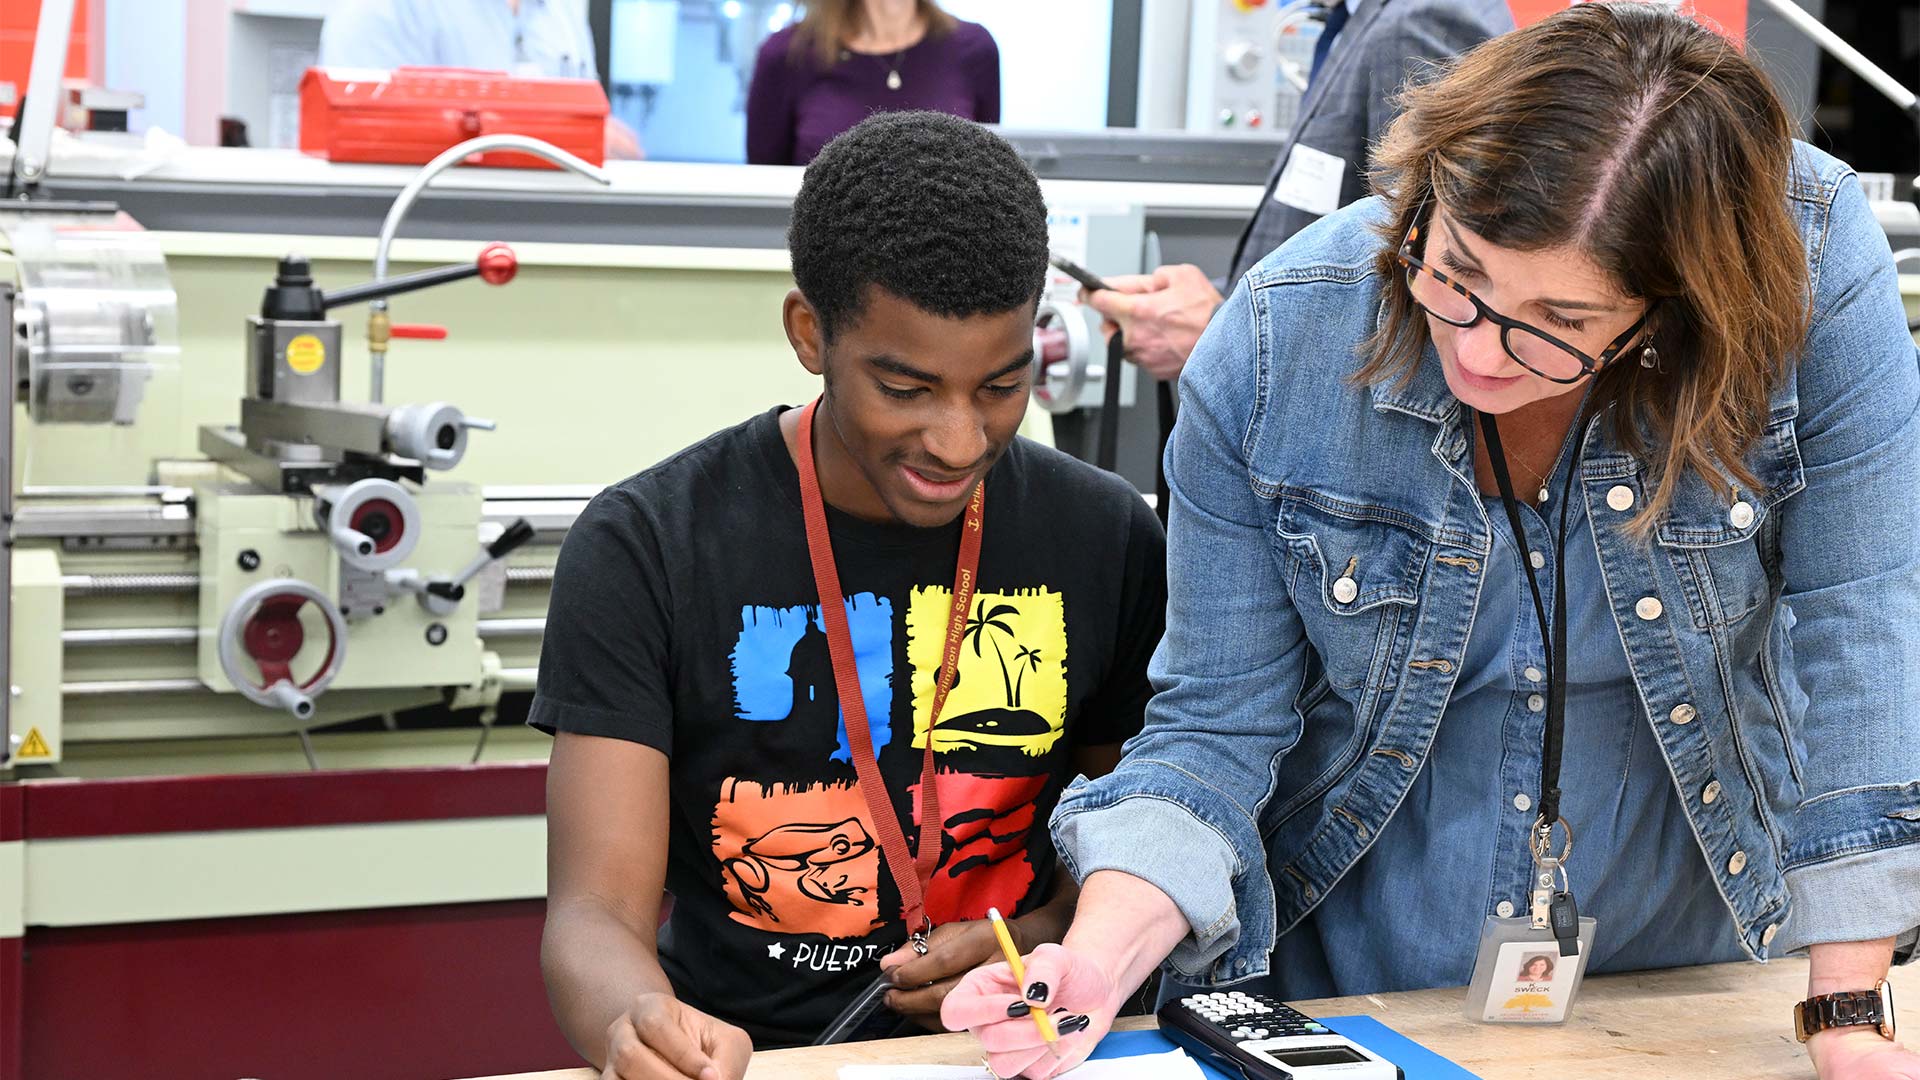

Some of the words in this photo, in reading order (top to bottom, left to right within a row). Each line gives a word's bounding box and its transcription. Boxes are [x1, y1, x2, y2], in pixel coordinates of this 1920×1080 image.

[956, 569, 971, 612] School
[950, 615, 963, 643] High
[938, 646, 956, 703] Arlington
